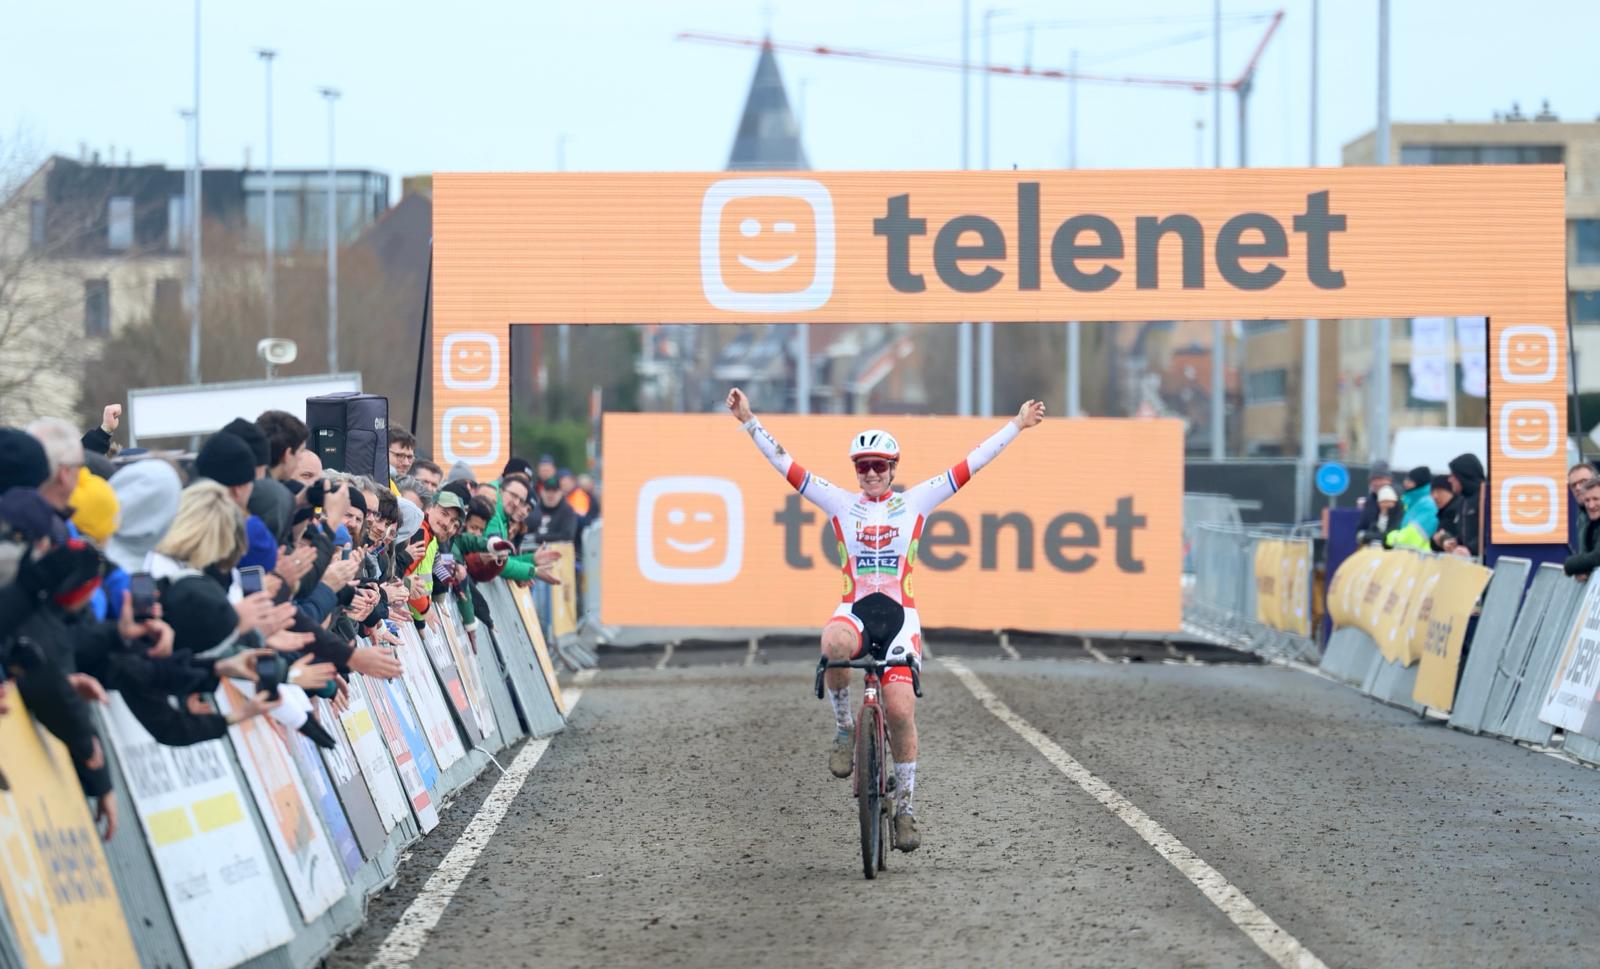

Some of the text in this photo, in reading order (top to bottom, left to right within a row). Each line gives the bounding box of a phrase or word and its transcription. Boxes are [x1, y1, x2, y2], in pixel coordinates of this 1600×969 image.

[873, 182, 1348, 292] telenet
[774, 494, 1147, 575] tenet
[858, 558, 897, 567] ALTEZ
